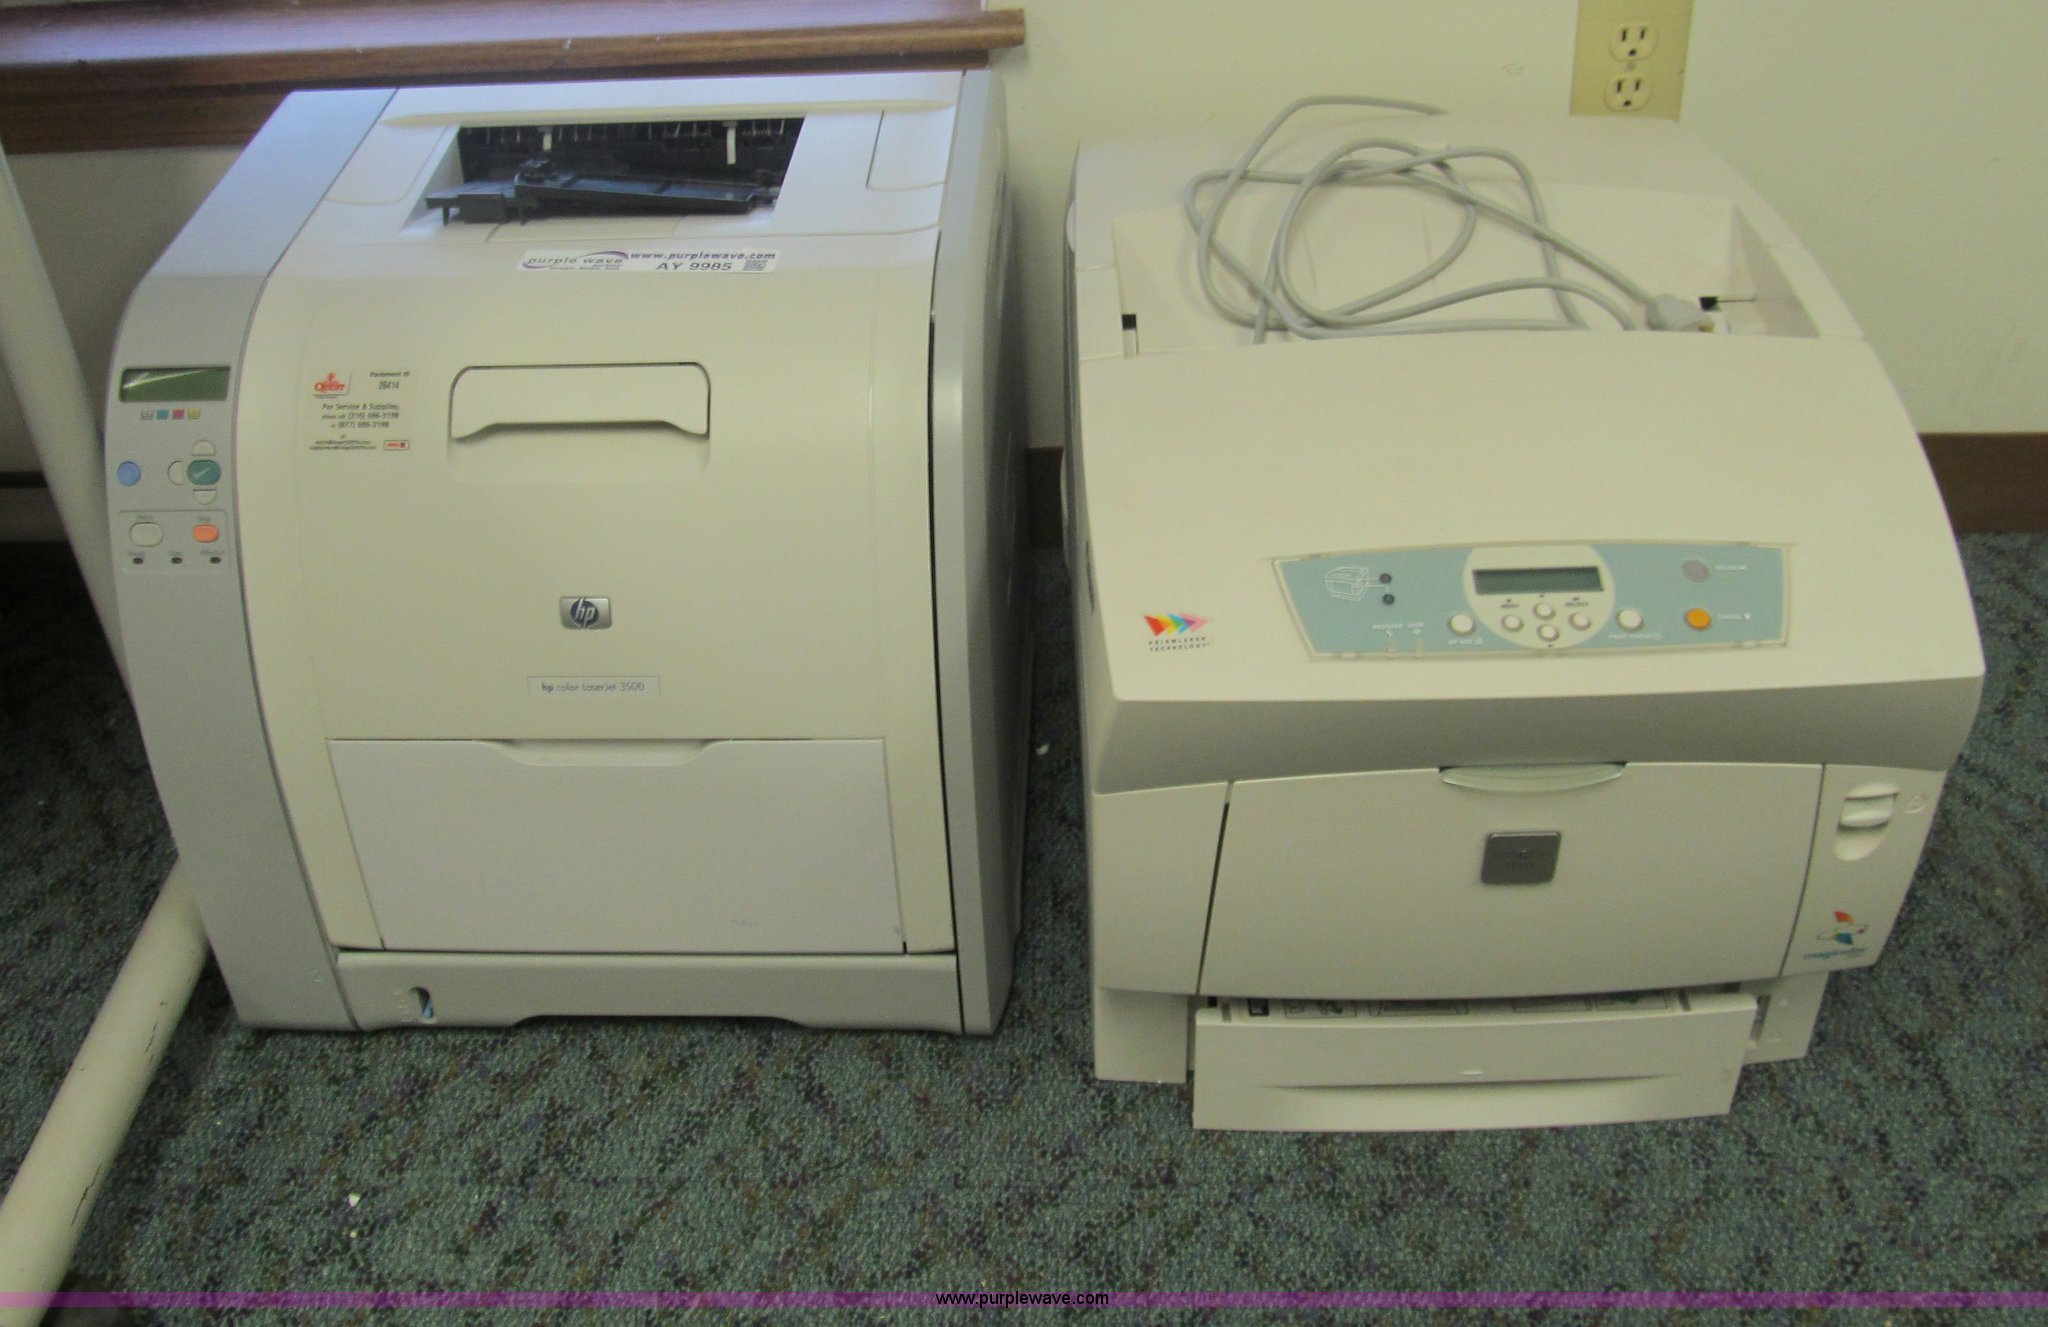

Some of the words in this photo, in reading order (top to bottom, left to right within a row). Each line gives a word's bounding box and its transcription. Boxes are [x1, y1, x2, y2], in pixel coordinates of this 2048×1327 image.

[527, 256, 577, 266] purple
[583, 257, 624, 265] wave
[630, 251, 775, 261] www.purplewave.com
[655, 262, 683, 271] AY
[689, 262, 732, 271] 9985
[541, 682, 554, 694] hp
[620, 681, 645, 692] 3500
